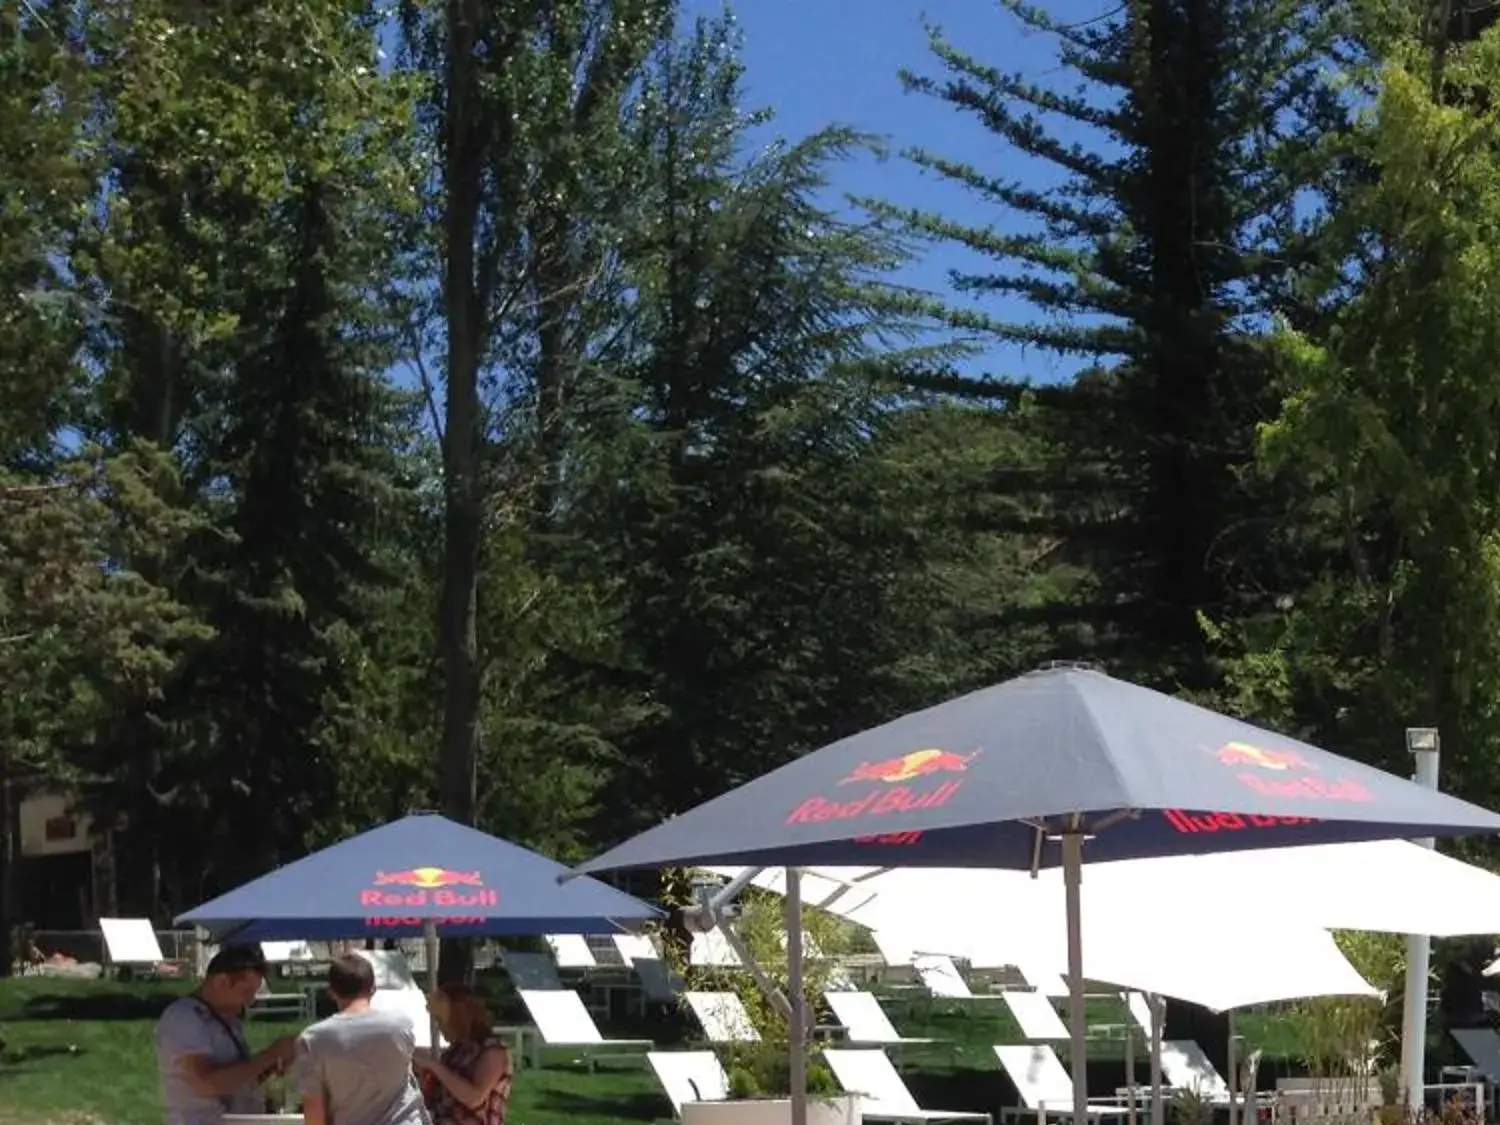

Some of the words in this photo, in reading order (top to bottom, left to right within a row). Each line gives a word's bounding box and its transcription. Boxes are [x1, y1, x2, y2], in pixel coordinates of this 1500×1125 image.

[786, 789, 882, 825] Red
[869, 778, 963, 816] Bull
[360, 889, 427, 907] Red
[434, 889, 498, 907] Bull
